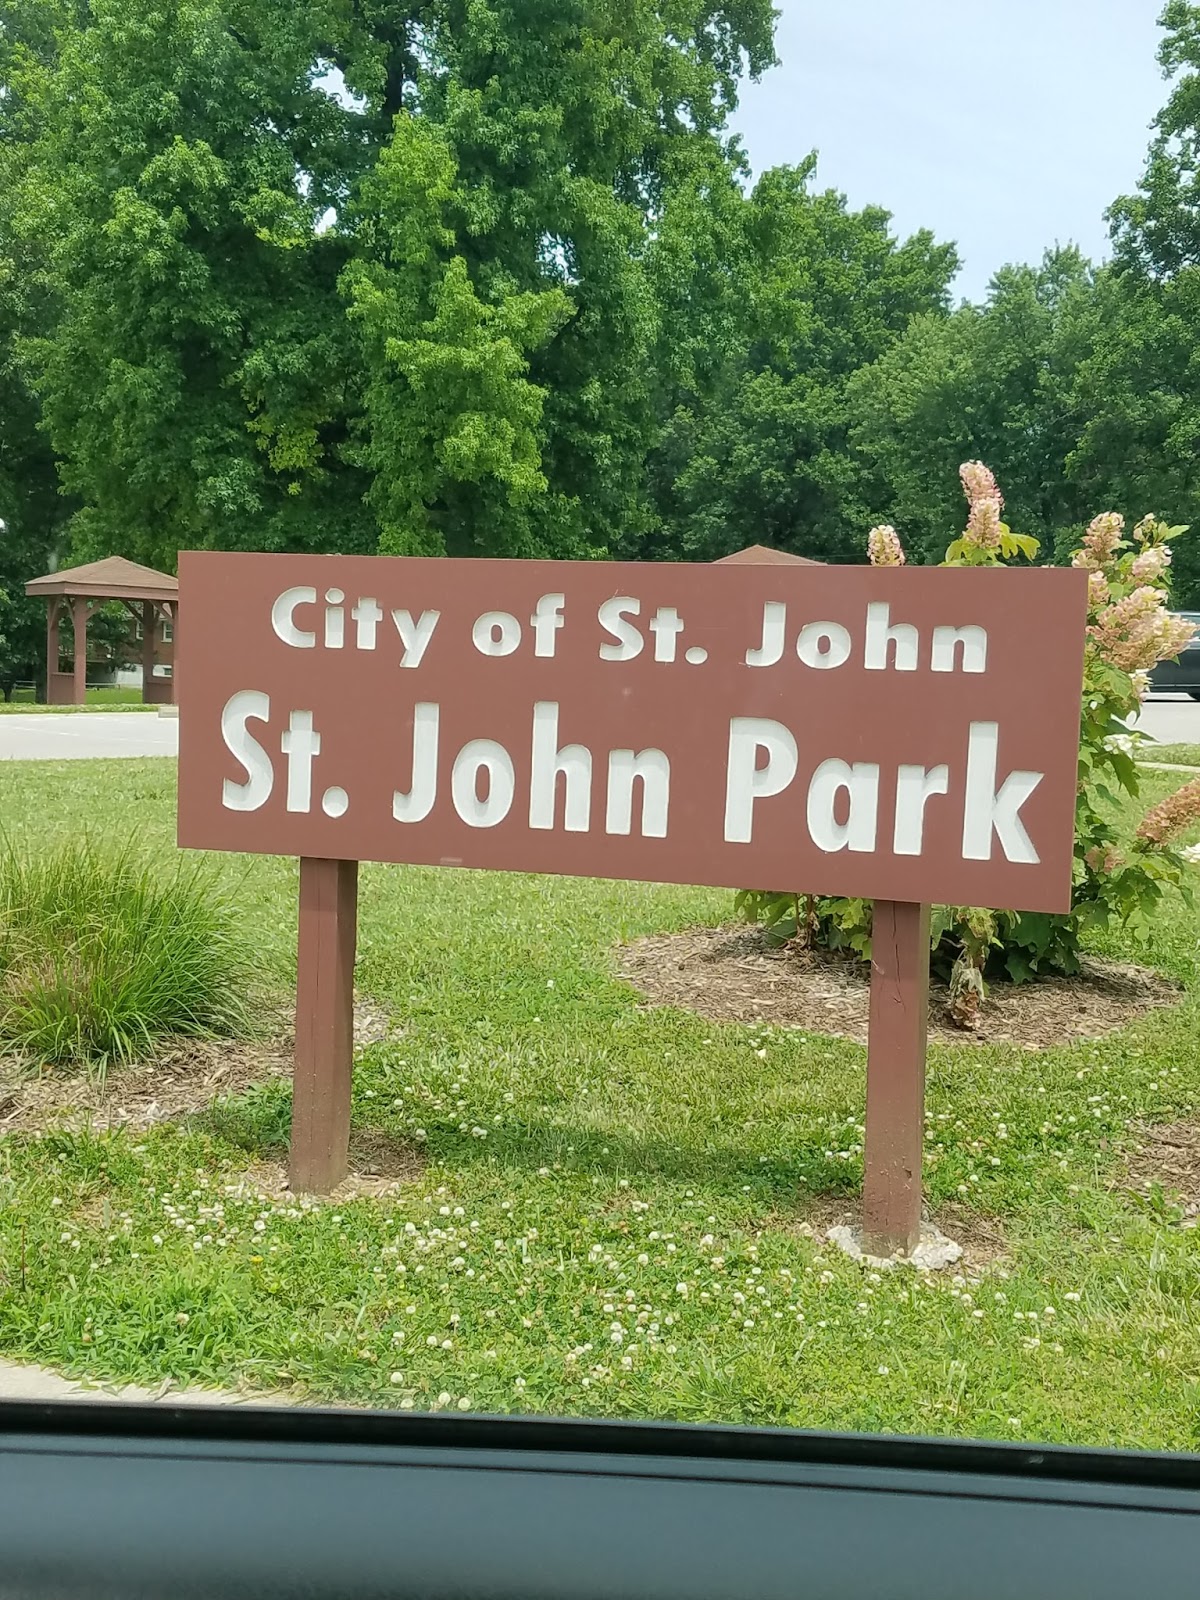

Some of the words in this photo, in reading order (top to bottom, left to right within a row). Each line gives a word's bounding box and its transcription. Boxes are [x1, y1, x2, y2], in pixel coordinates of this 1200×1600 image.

[271, 586, 440, 669] City
[472, 592, 565, 658] of
[598, 595, 708, 665] St.
[745, 601, 988, 673] John
[221, 690, 349, 818] St.
[392, 701, 671, 838] John
[724, 716, 1044, 864] Park
